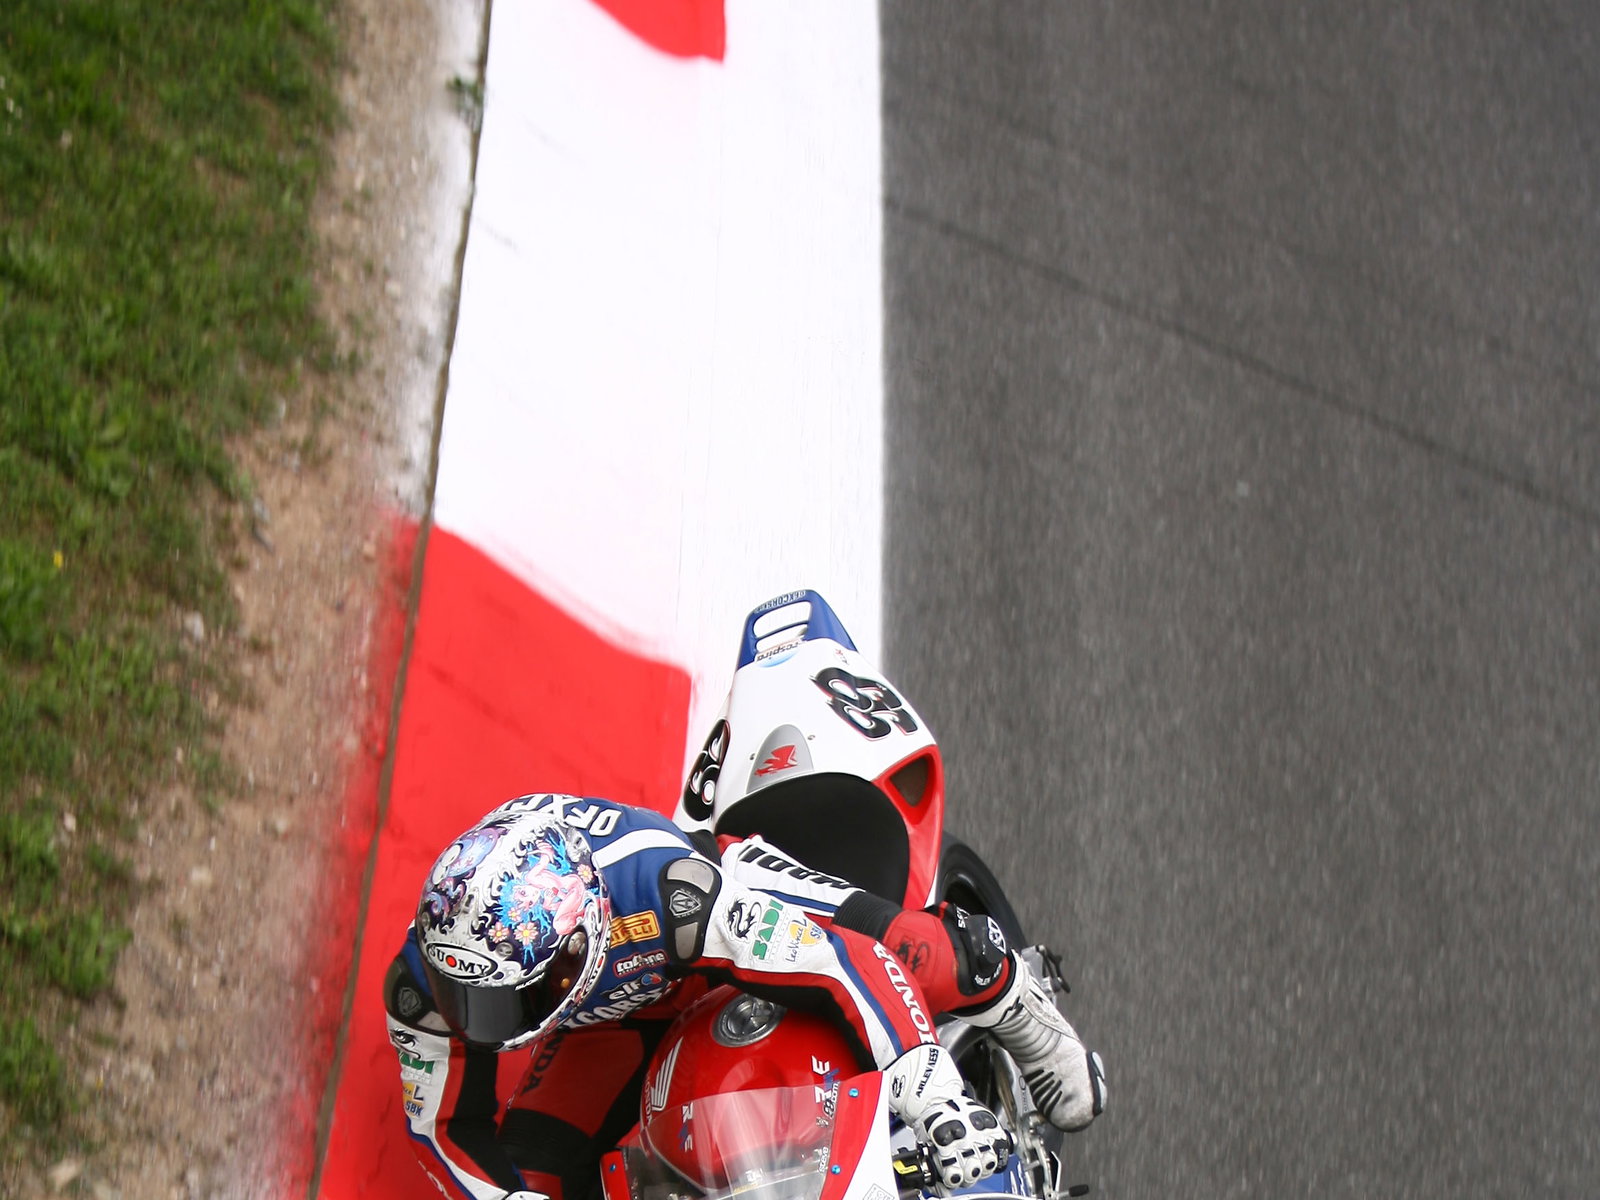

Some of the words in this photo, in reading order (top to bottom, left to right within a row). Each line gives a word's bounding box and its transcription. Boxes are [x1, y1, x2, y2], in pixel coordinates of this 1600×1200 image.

[611, 923, 654, 944] IRELLI
[752, 898, 784, 960] SADI
[608, 982, 641, 1001] elf
